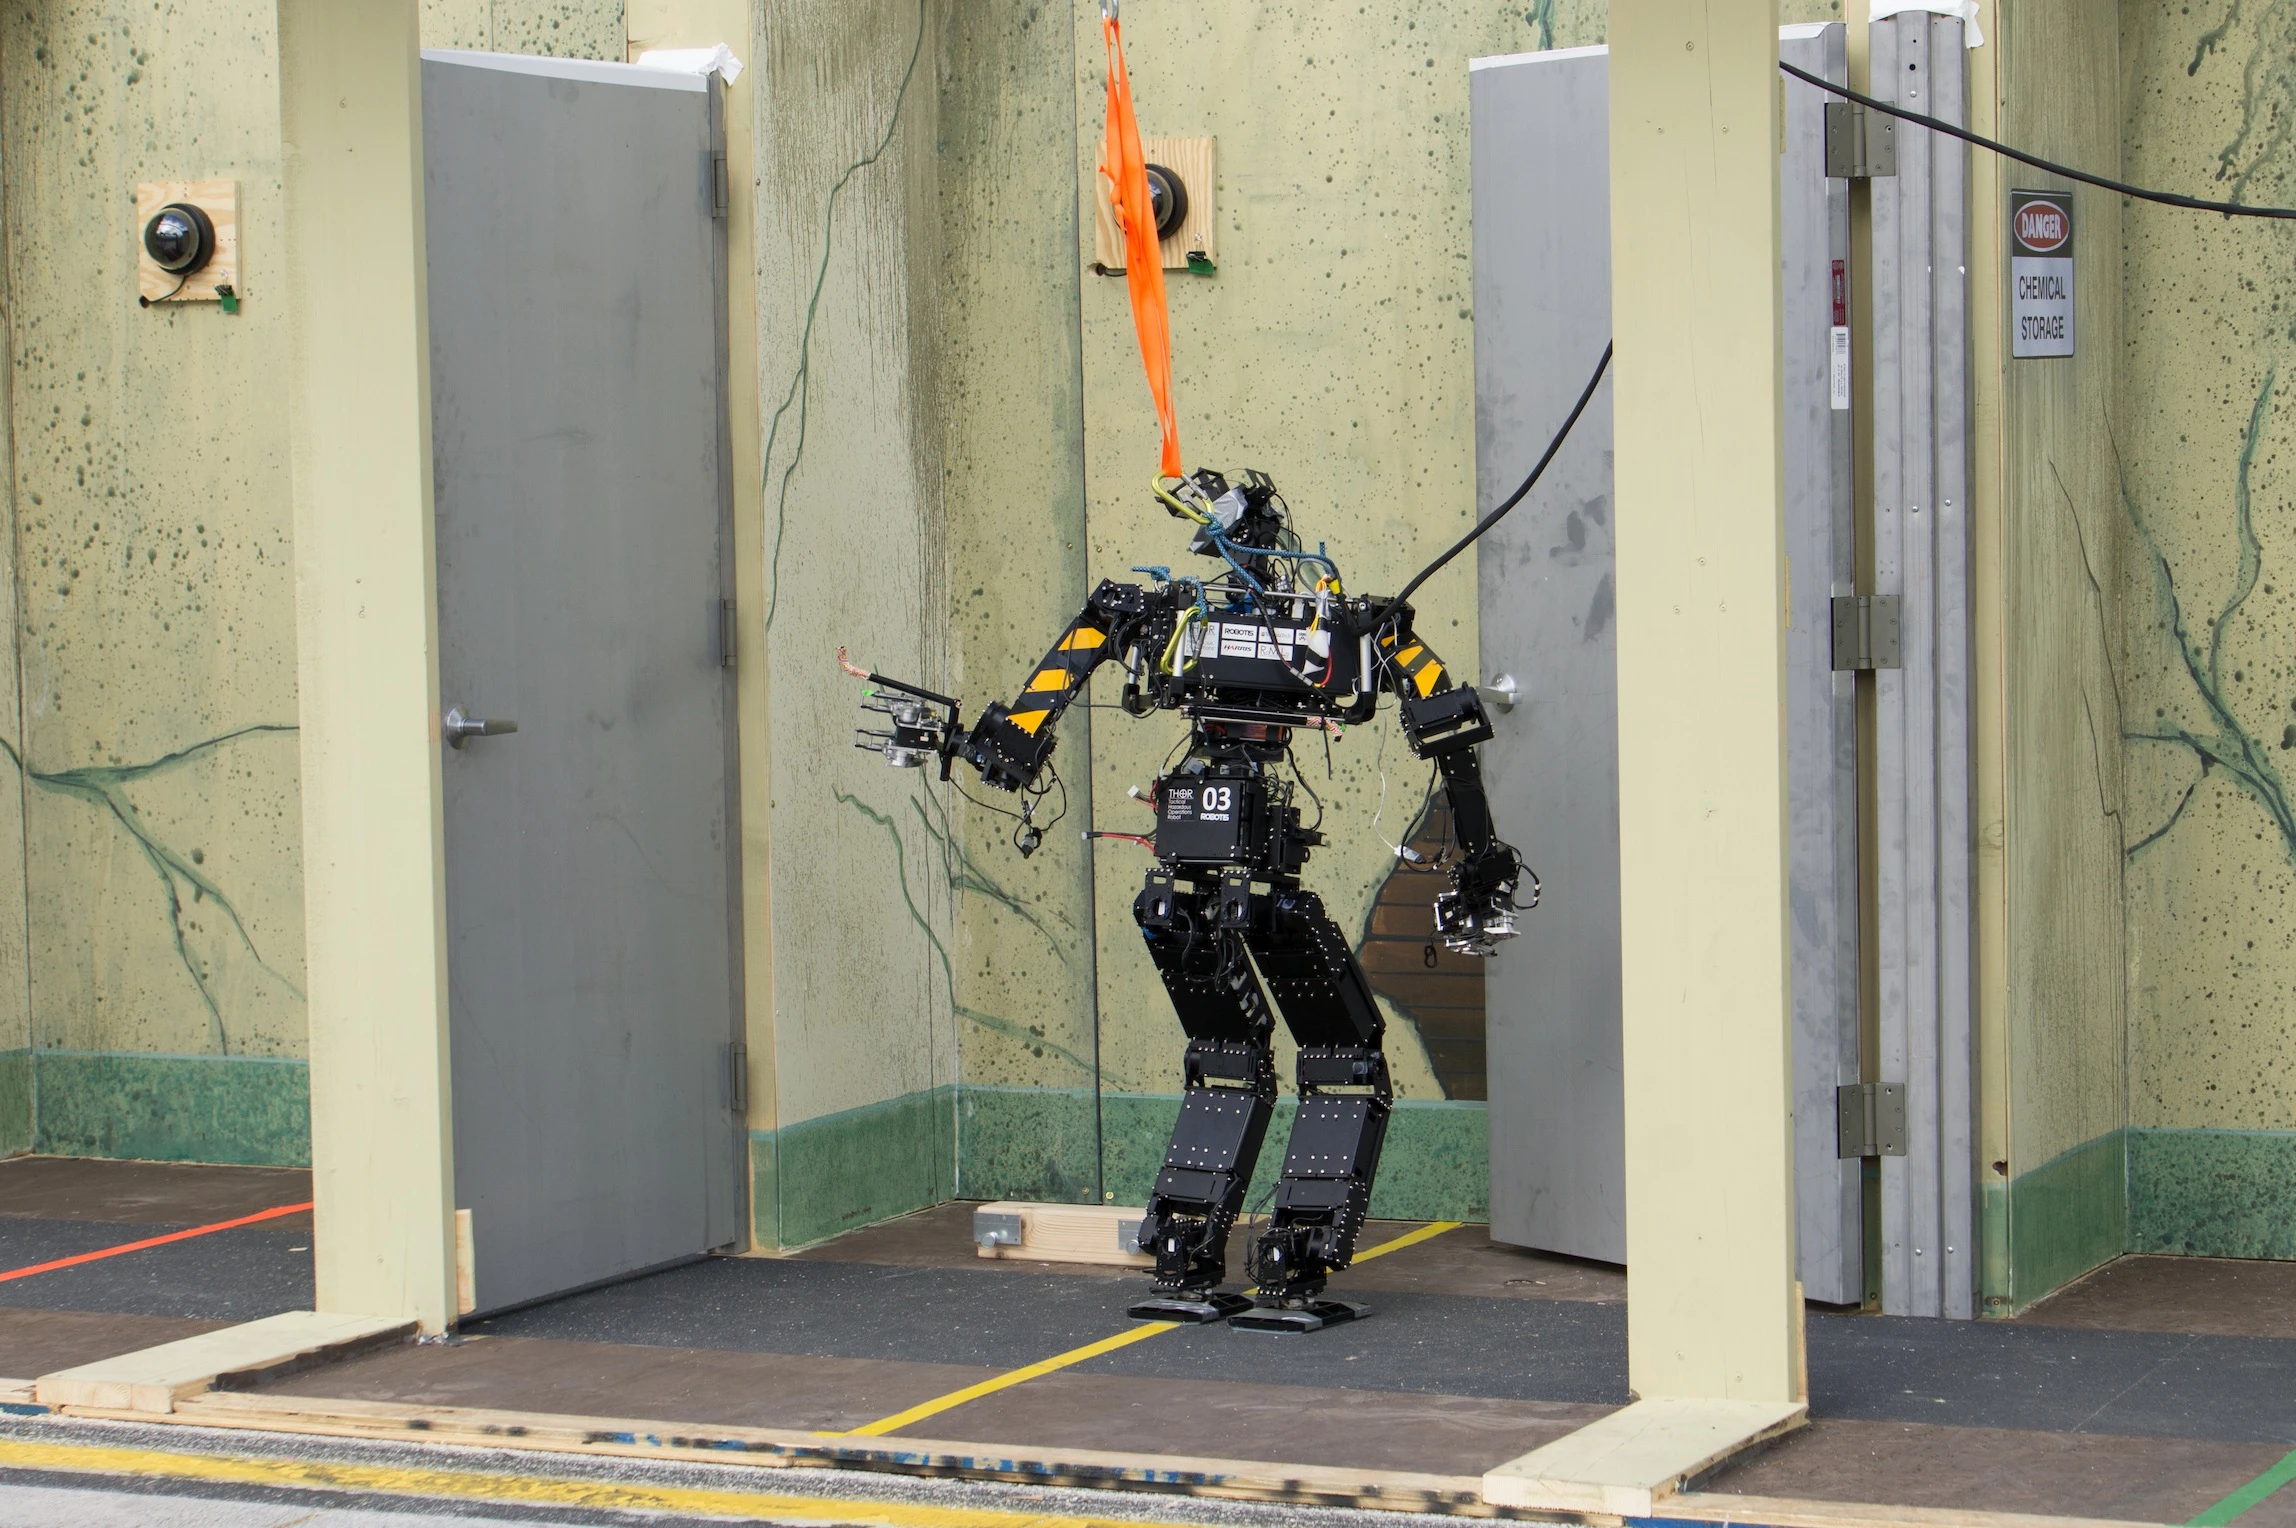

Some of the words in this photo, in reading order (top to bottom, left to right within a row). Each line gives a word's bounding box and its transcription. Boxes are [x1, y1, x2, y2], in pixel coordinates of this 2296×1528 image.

[2021, 212, 2062, 240] DANGER
[2019, 275, 2066, 300] CHEMICAL
[2021, 316, 2065, 341] STORAGE
[1224, 627, 1254, 636] ROBOTIS
[1223, 644, 1252, 652] HARRIS
[1168, 789, 1193, 799] THOR
[1203, 786, 1231, 811] 03
[1200, 812, 1230, 821] ROBOTIS
